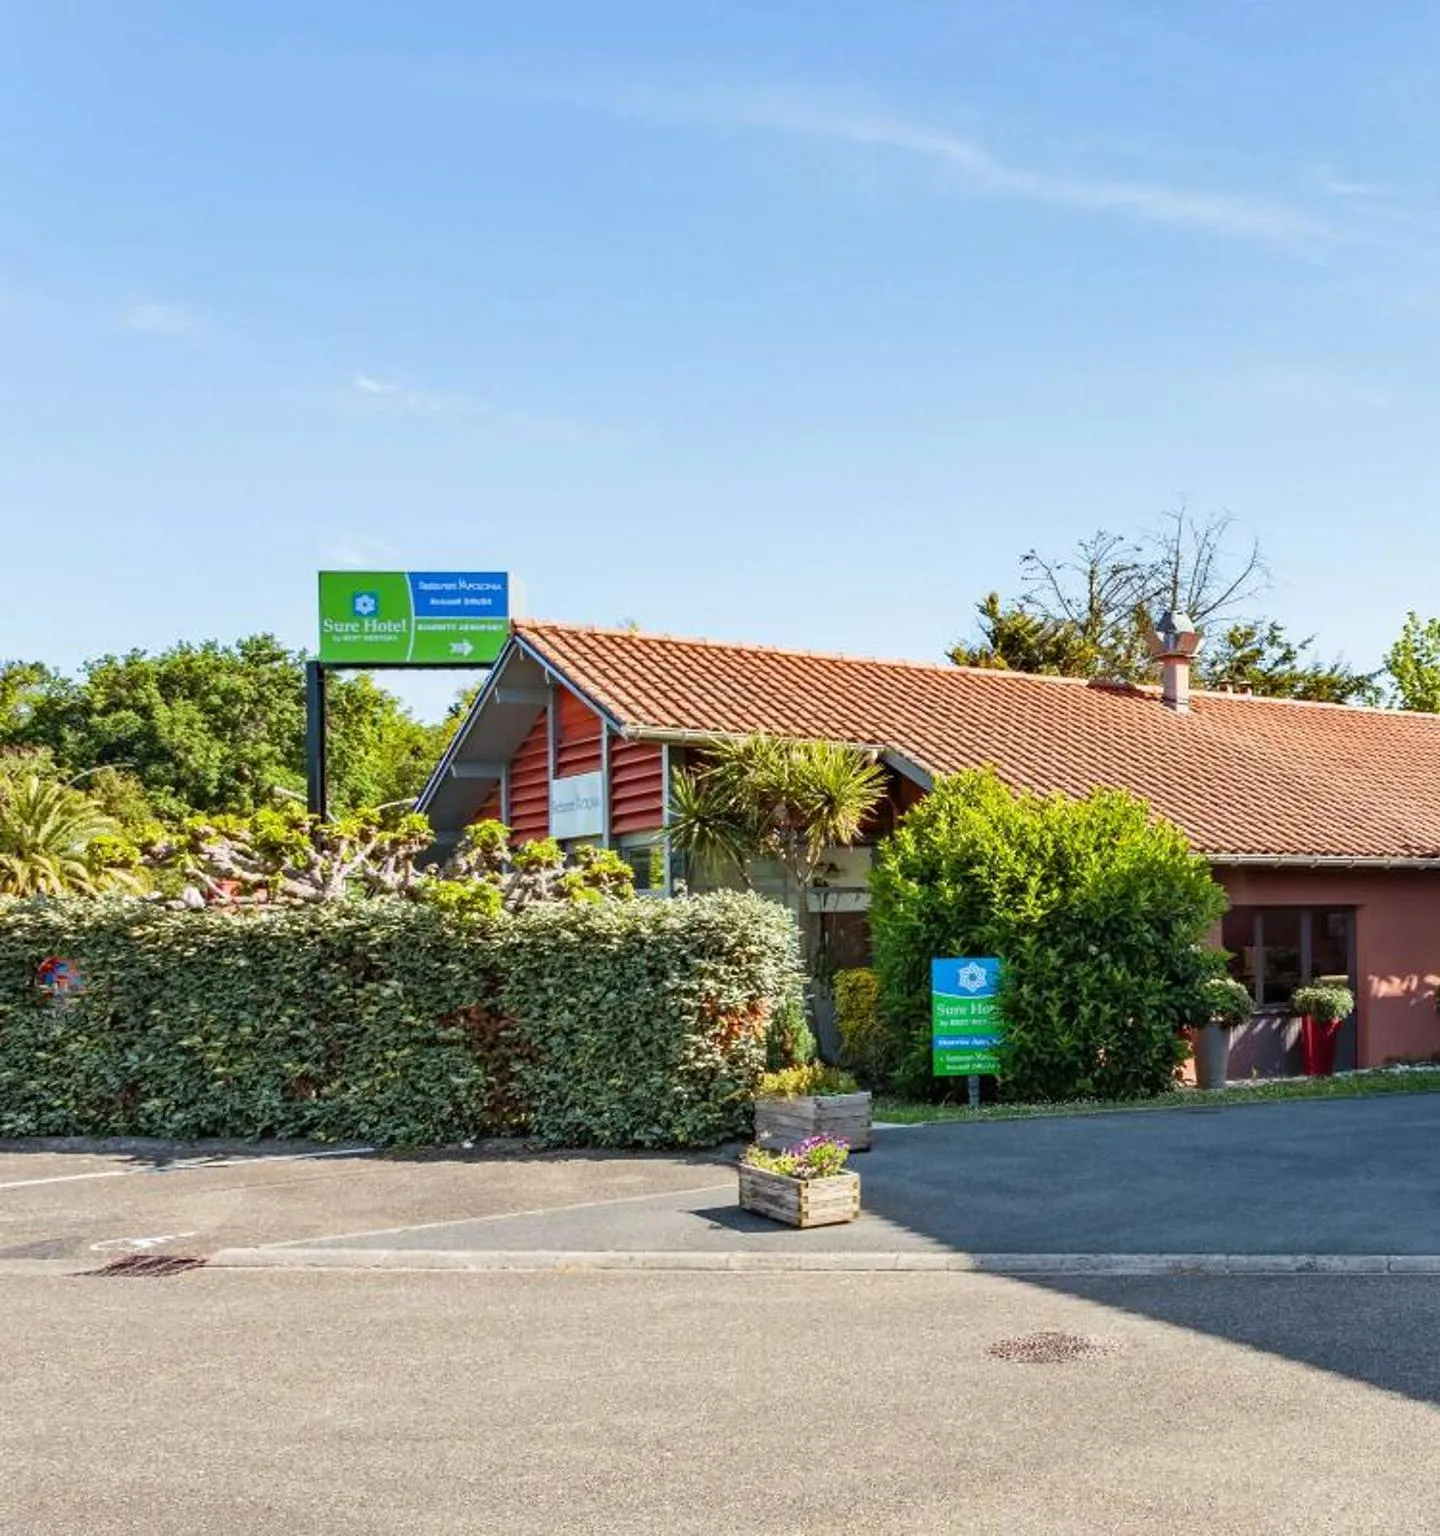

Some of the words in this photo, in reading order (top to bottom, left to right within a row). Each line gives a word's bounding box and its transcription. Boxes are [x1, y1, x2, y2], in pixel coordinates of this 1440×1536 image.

[323, 618, 360, 633] Sure
[364, 618, 407, 633] Hotel
[936, 1003, 968, 1016] Sure
